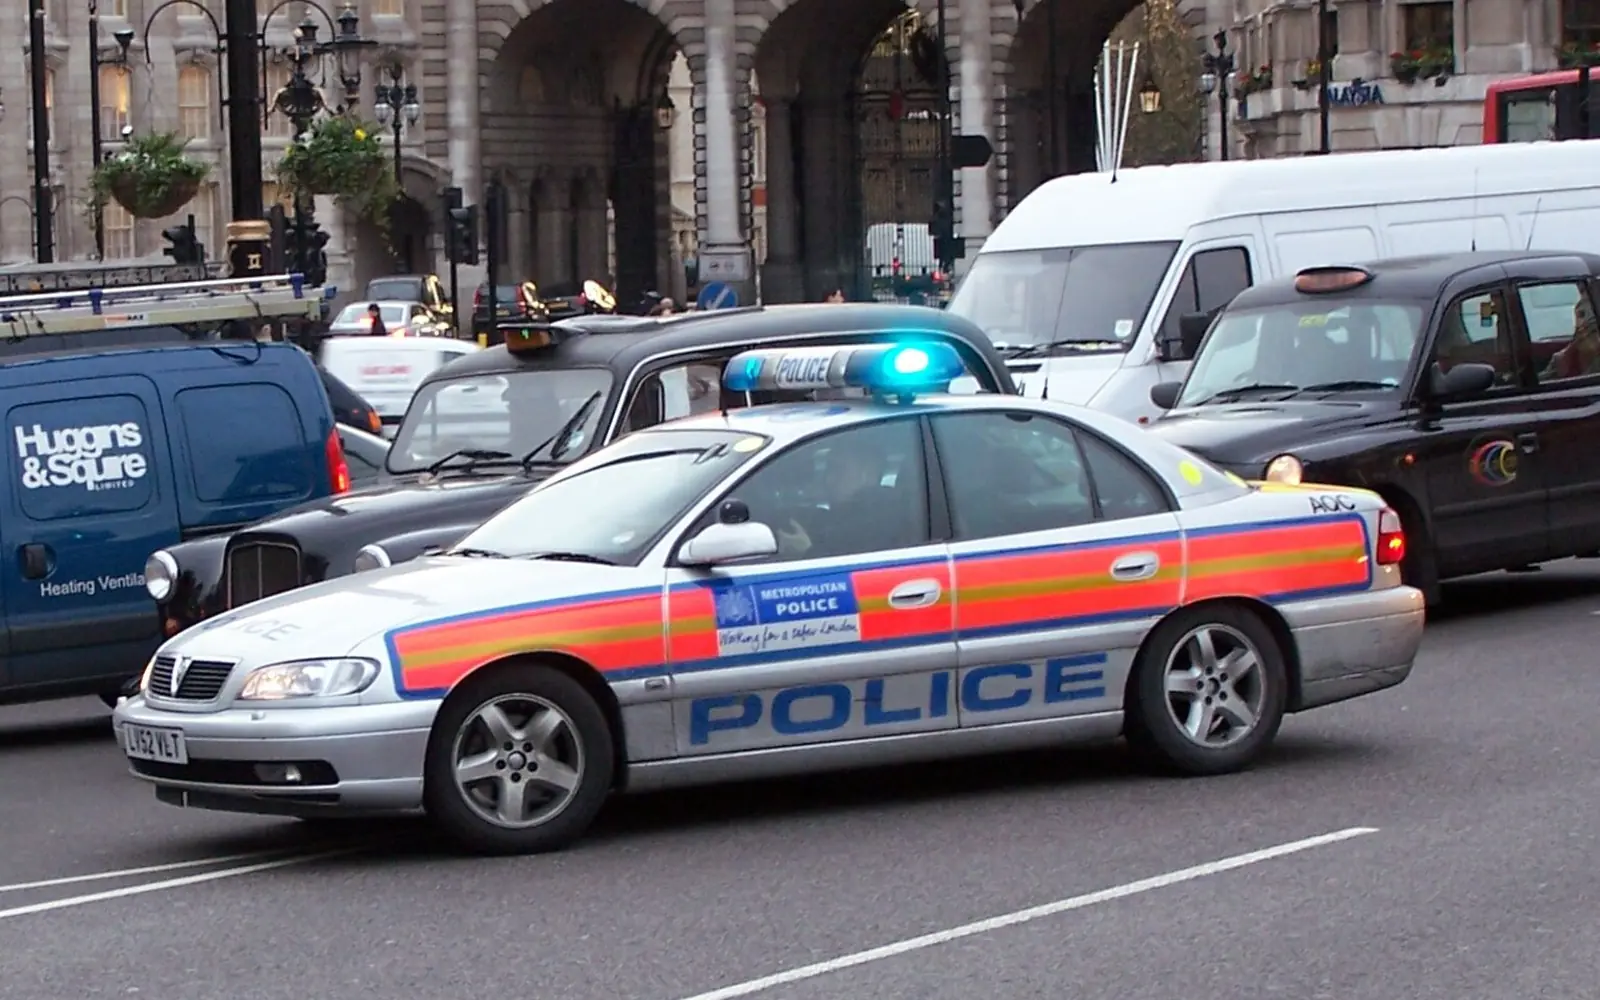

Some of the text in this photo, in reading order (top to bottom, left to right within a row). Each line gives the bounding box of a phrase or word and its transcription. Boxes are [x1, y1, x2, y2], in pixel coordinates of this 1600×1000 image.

[779, 356, 829, 383] POLICE
[95, 479, 135, 491] LIMITED
[40, 579, 96, 597] Heating
[760, 581, 847, 600] METROPOLITAN
[775, 597, 838, 616] POLICE
[719, 619, 858, 651] Working for a safer London
[689, 652, 1108, 746] POLICE
